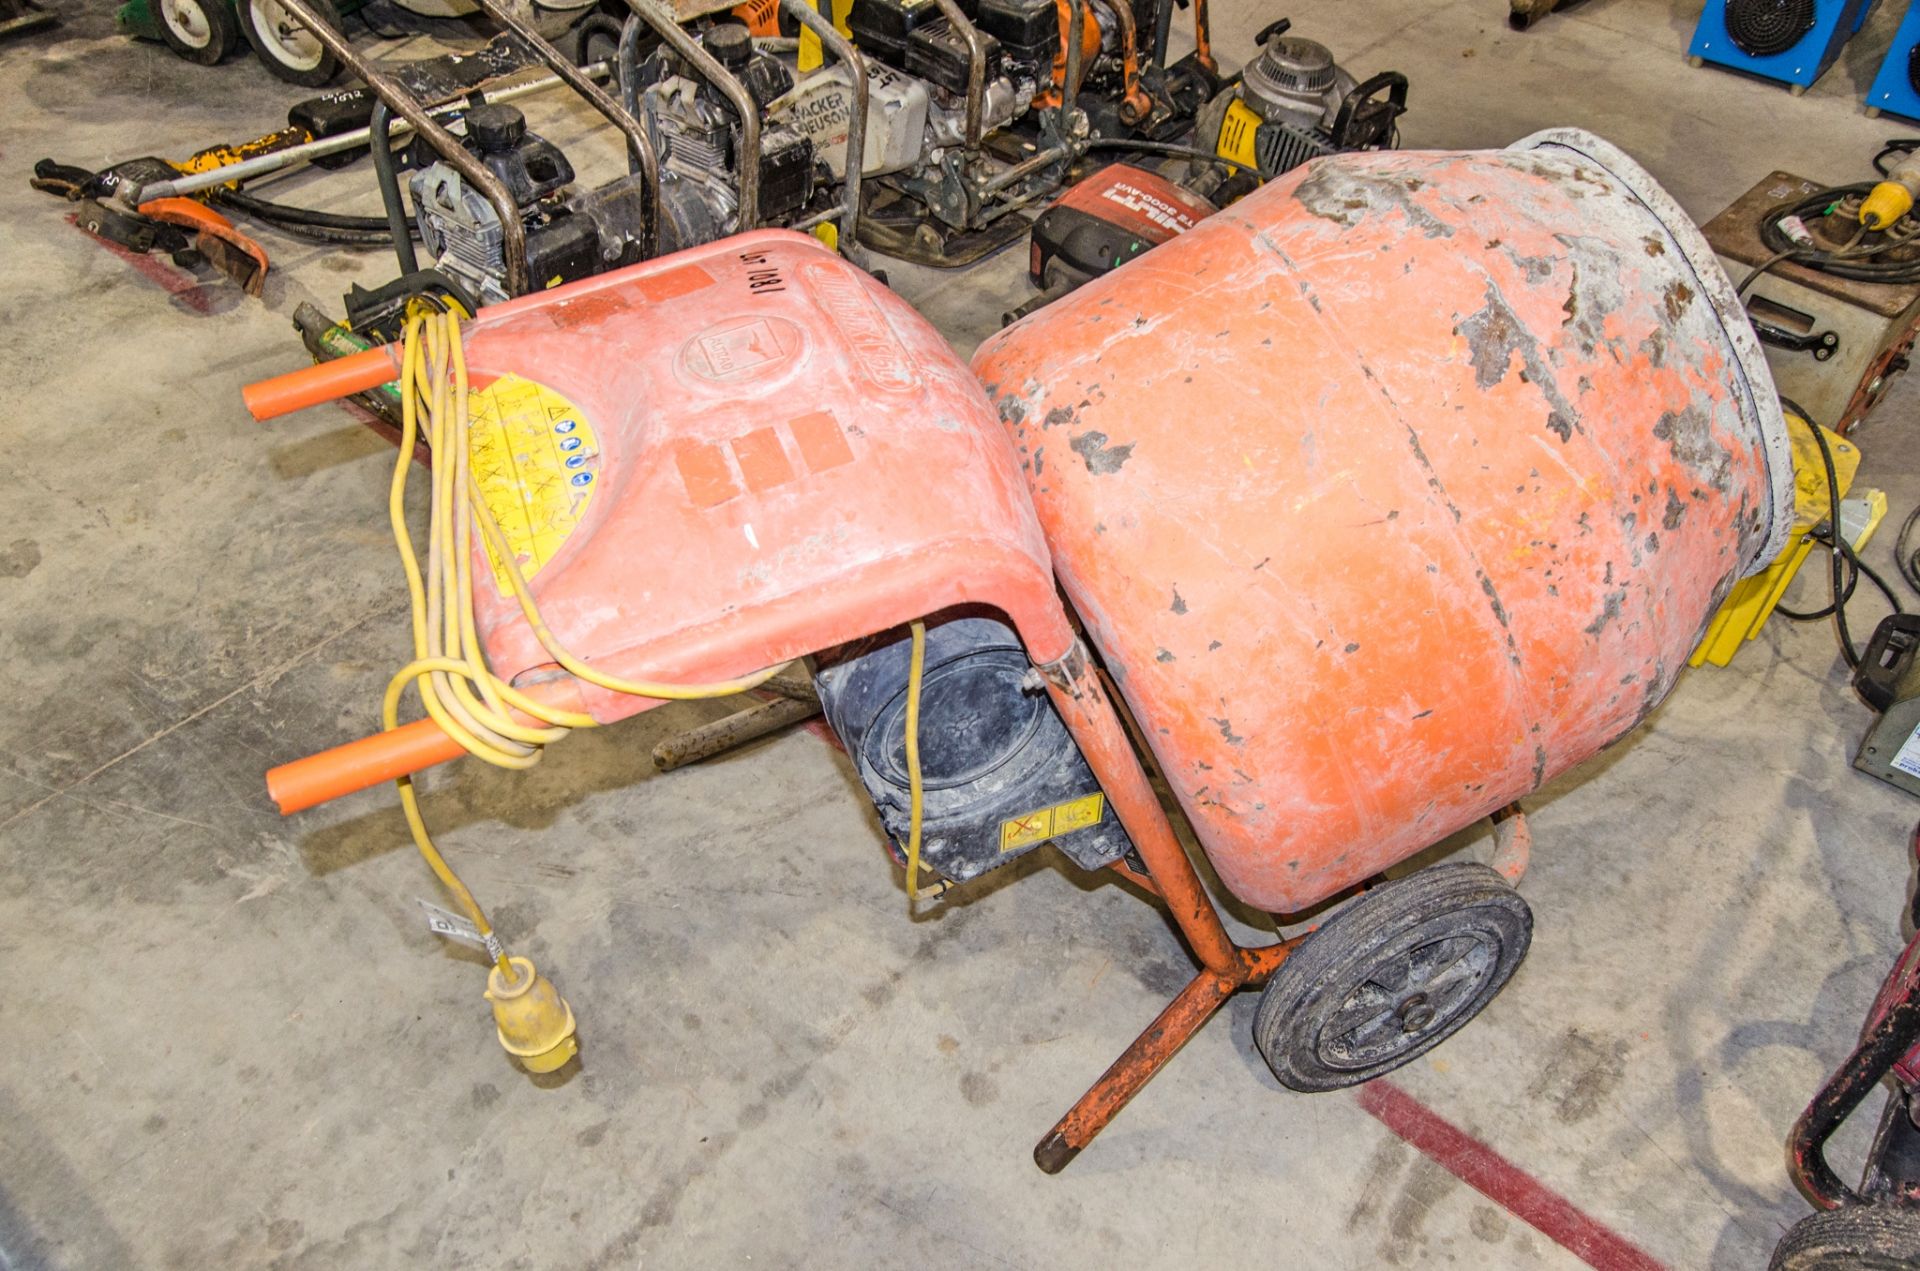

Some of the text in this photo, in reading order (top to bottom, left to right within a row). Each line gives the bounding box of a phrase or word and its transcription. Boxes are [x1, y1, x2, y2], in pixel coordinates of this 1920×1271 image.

[1102, 188, 1186, 234] HILTI
[1114, 182, 1178, 216] 3000-AVR
[747, 268, 786, 295] 1081
